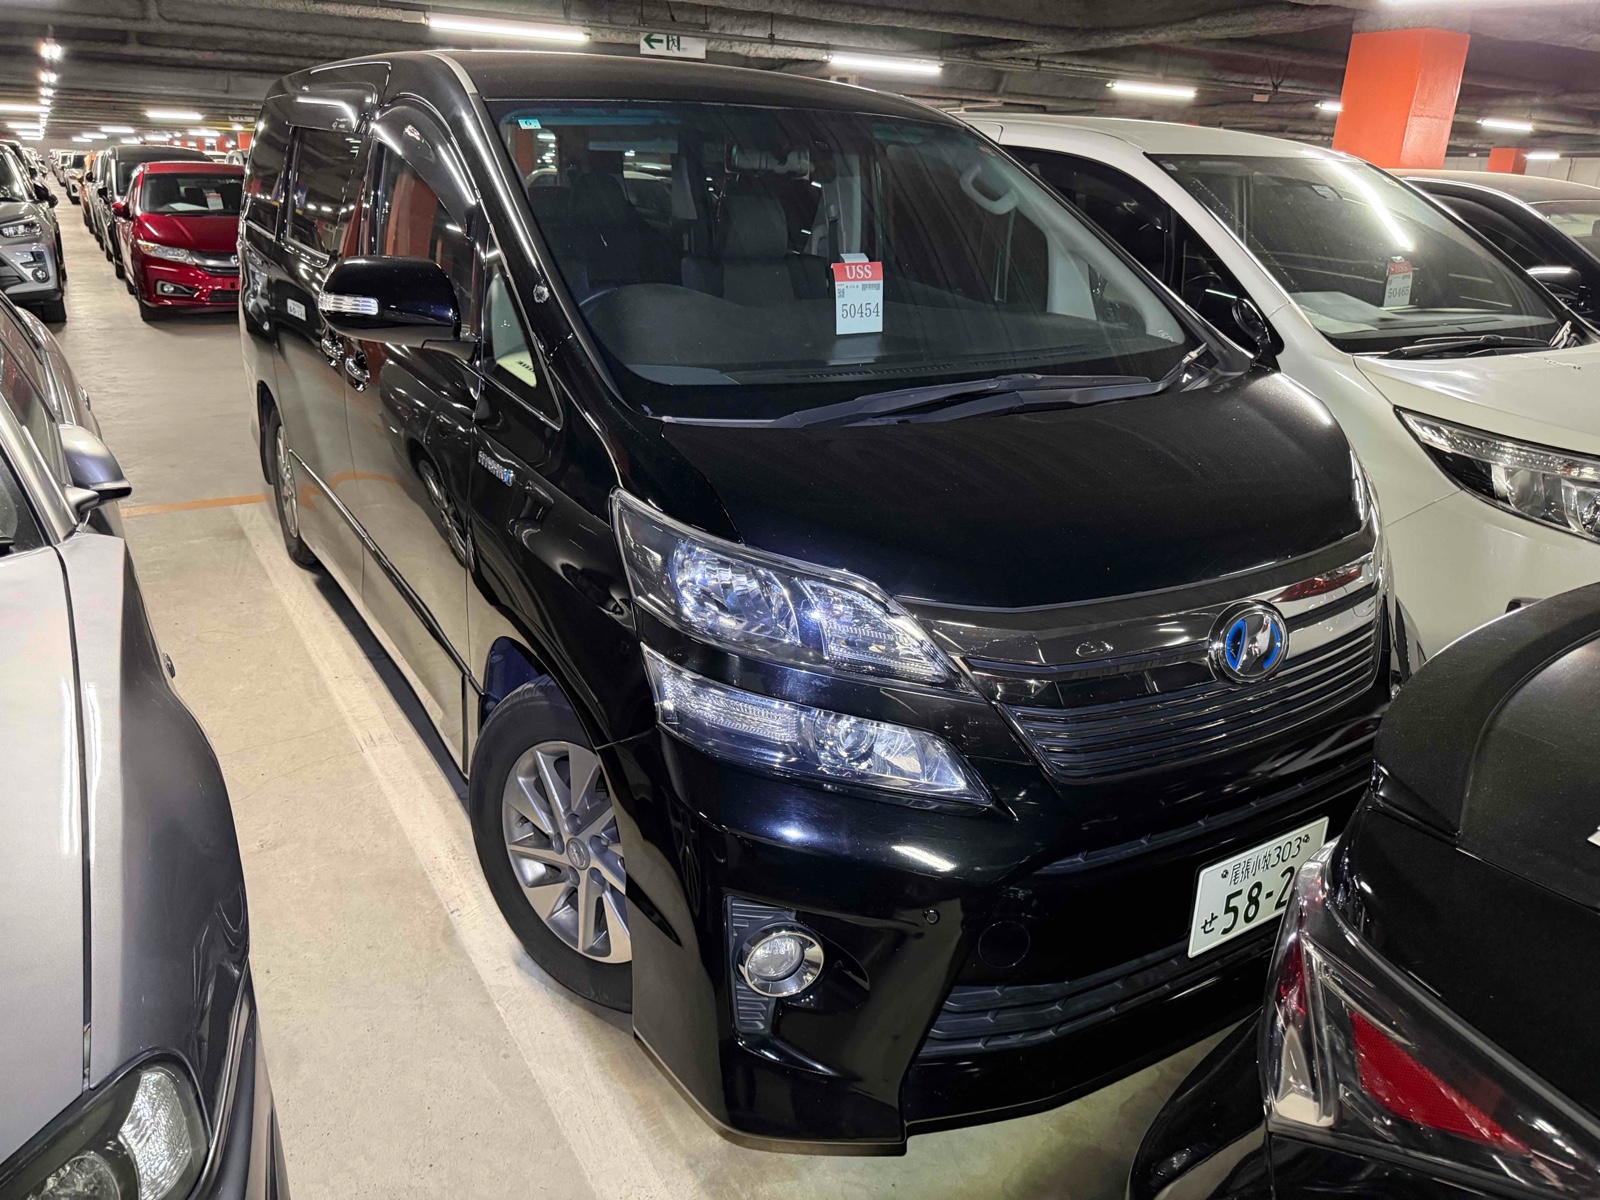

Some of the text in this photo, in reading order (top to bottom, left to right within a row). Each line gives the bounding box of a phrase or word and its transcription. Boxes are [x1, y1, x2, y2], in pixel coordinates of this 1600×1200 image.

[845, 264, 873, 280] USS
[841, 302, 881, 319] 50454
[1229, 836, 1302, 886] 尾張小牧 303
[1200, 865, 1296, 936] せ 58-2
